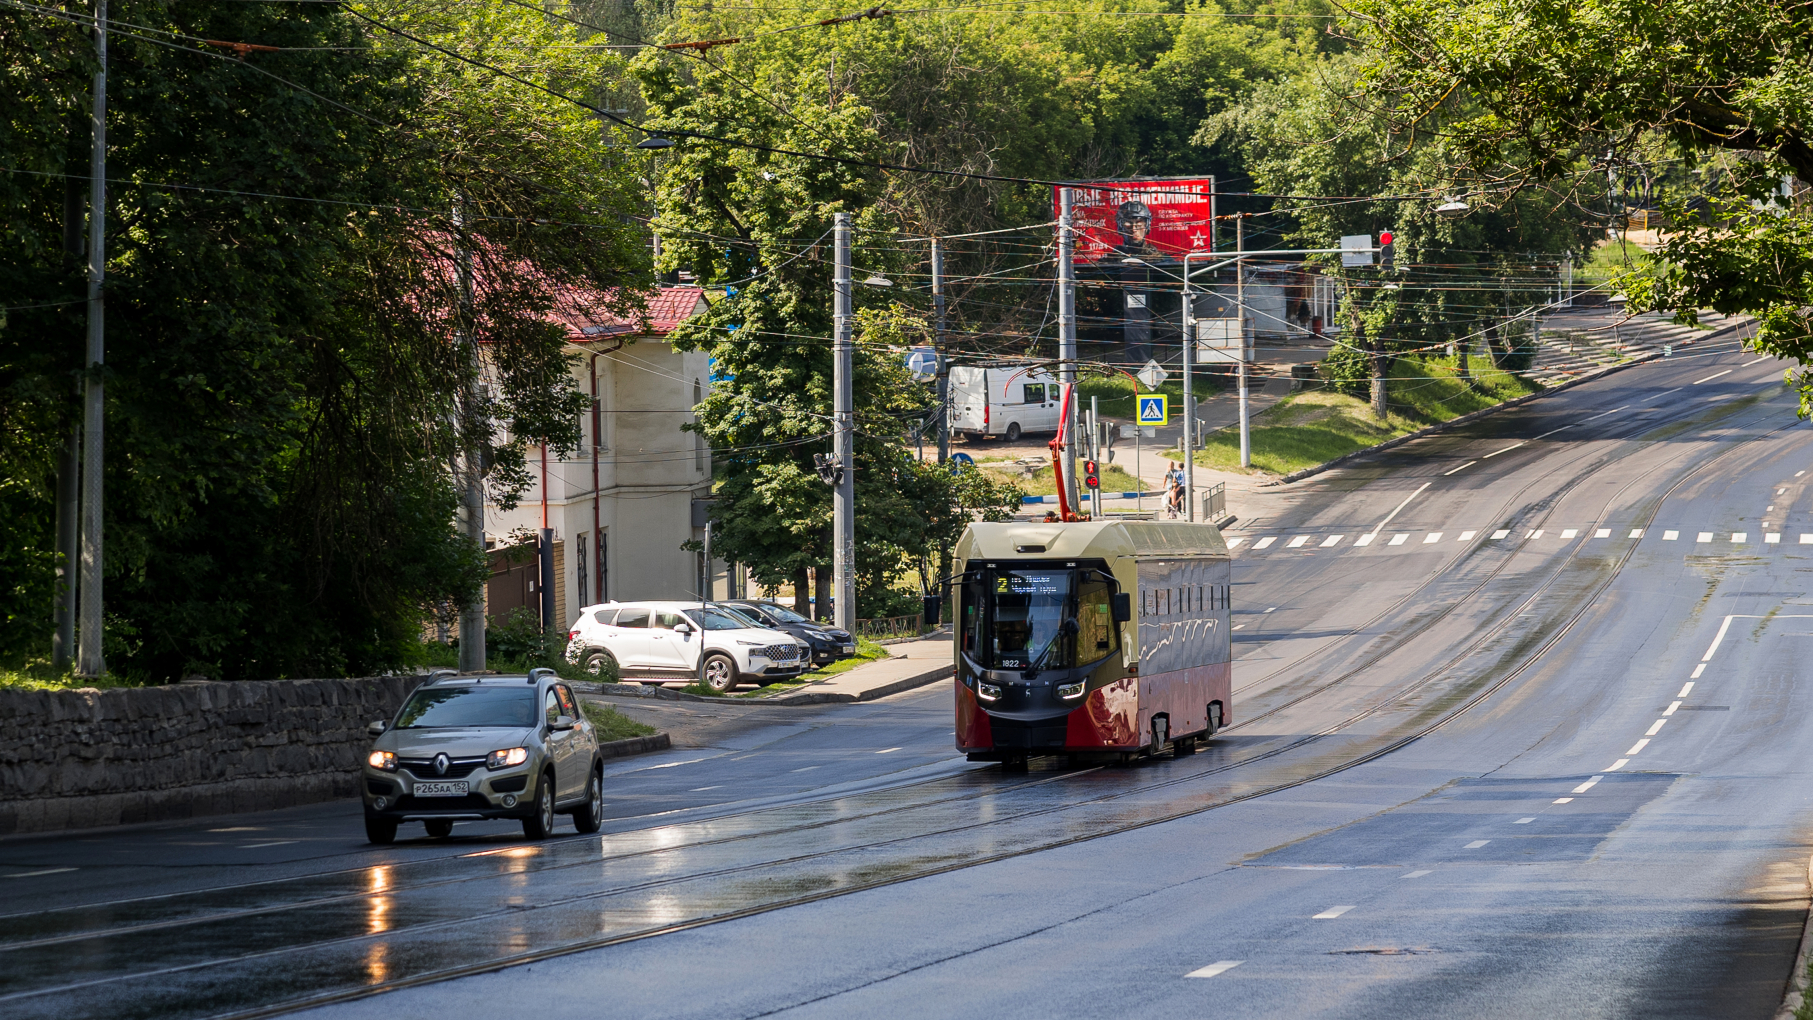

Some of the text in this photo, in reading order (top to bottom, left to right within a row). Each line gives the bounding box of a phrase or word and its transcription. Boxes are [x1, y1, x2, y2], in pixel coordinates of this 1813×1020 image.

[1110, 185, 1207, 206] НЕЗАМЕНИМЫЕ.
[997, 577, 1008, 593] 2
[1002, 659, 1020, 668] 1822
